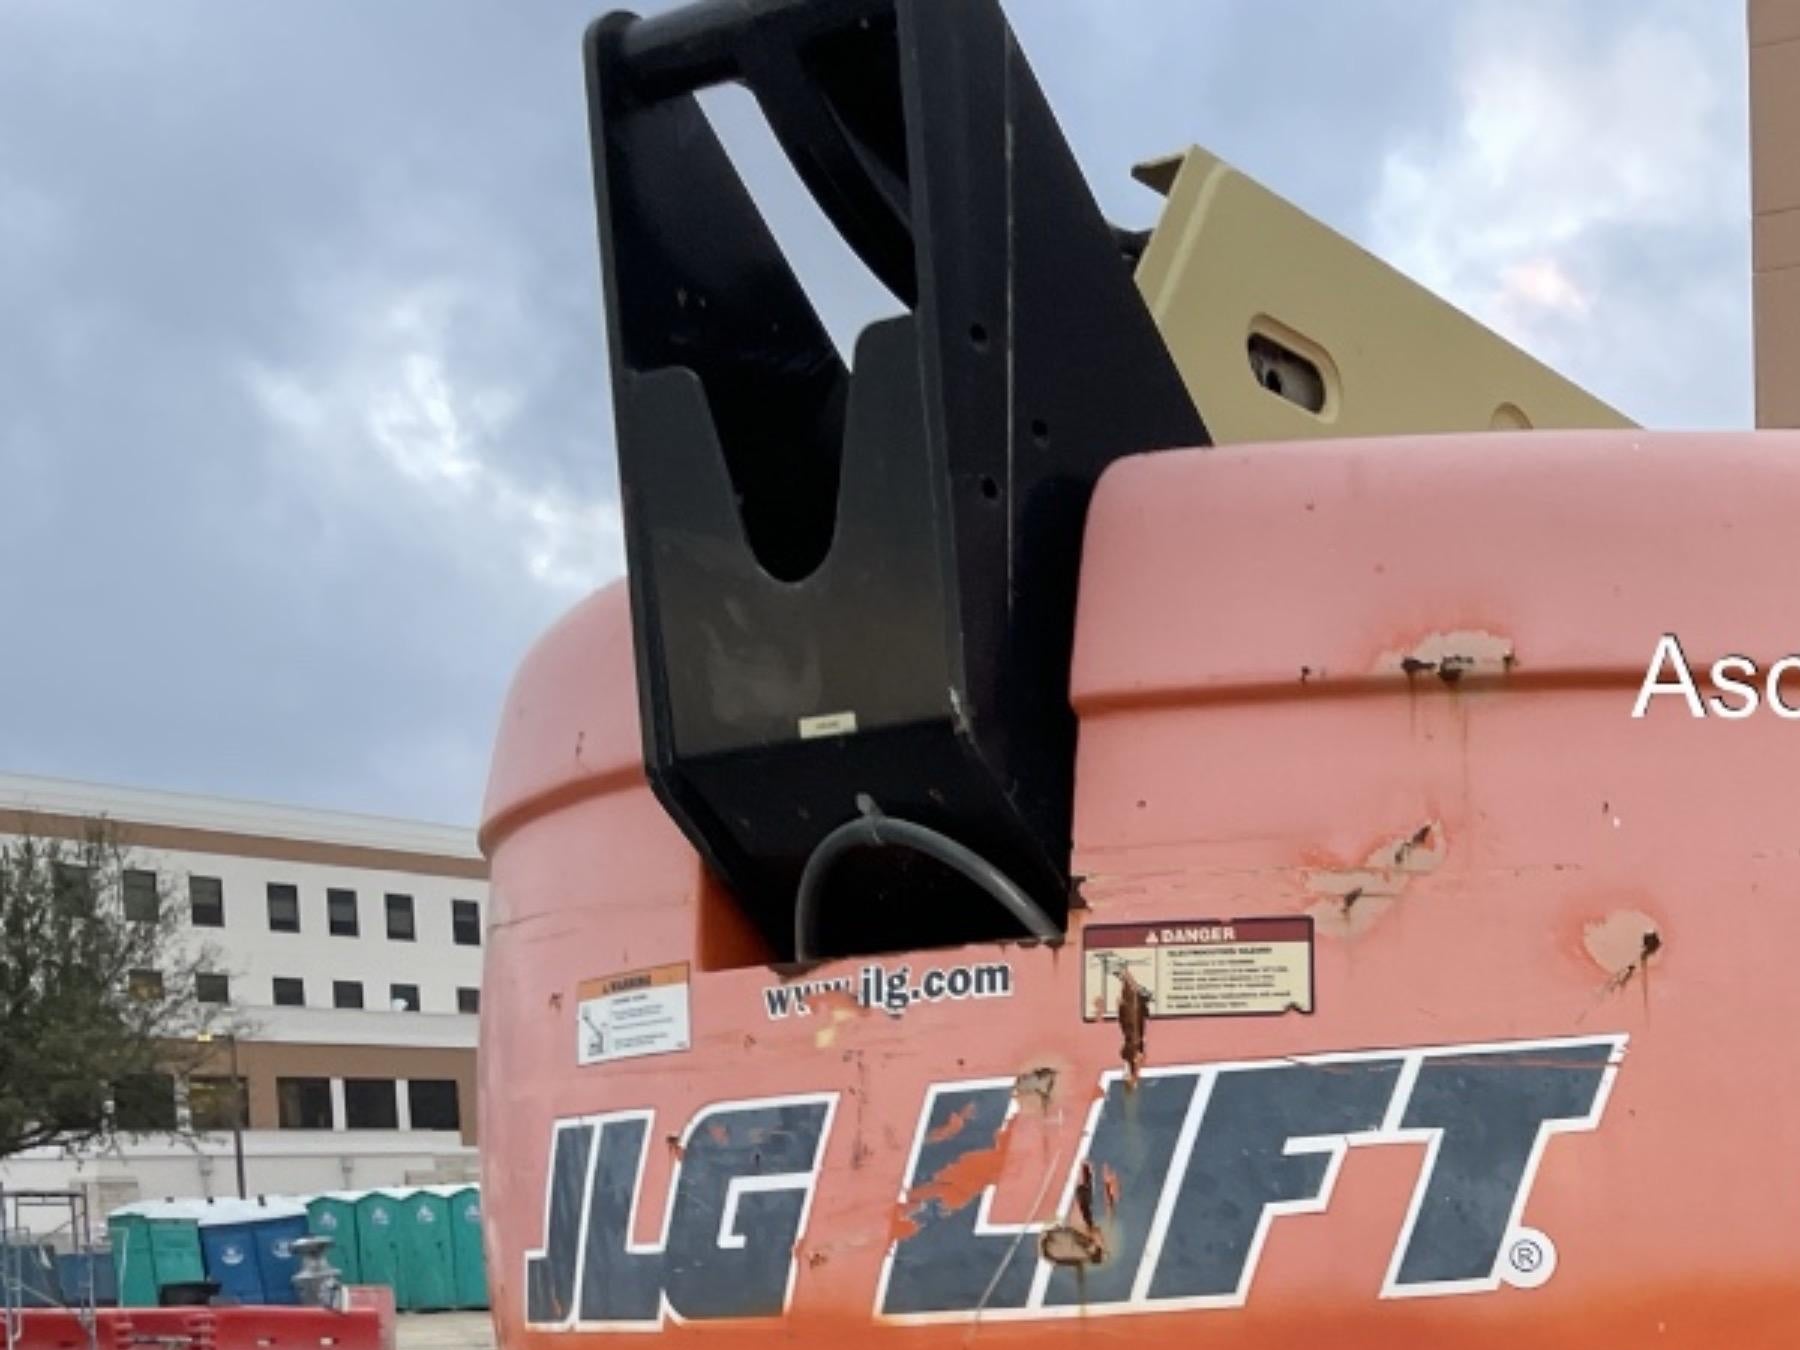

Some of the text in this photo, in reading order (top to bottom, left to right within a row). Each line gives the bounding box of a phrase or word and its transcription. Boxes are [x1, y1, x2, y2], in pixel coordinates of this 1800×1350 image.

[1160, 926, 1236, 943] DANGER
[763, 964, 1014, 1019] wwjlg.com
[524, 1032, 1631, 1332] JLG LIFT
